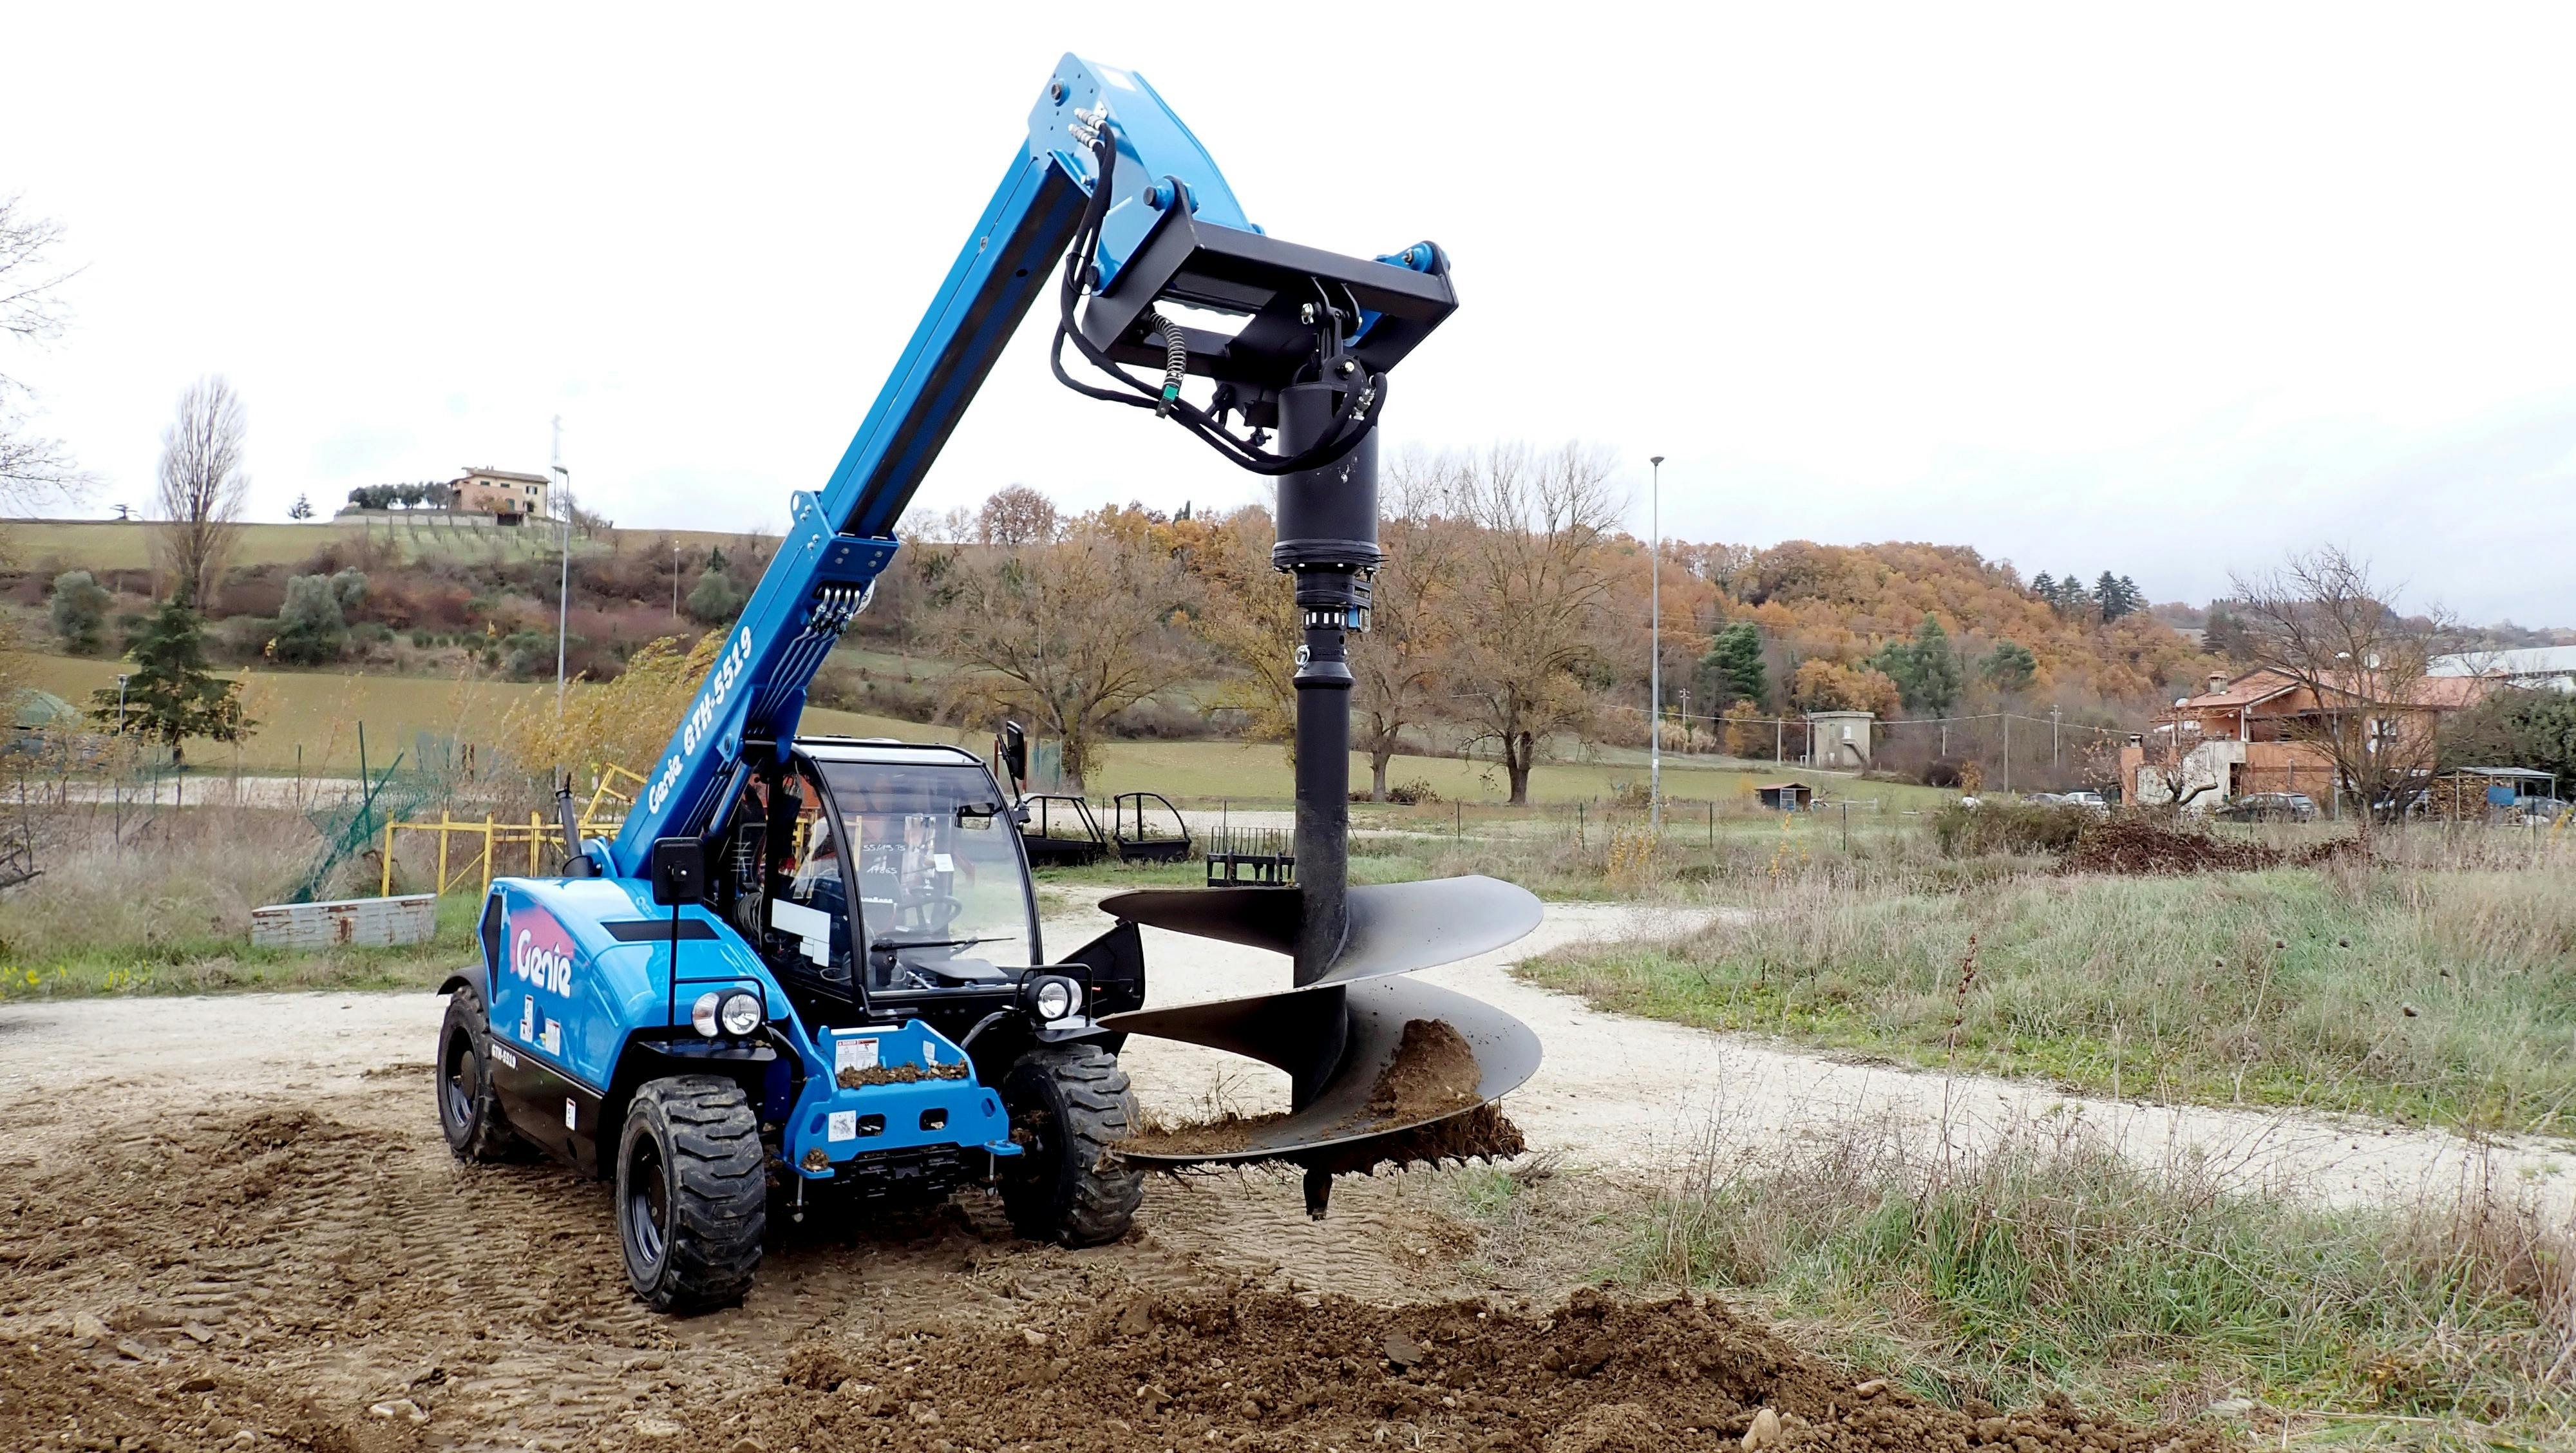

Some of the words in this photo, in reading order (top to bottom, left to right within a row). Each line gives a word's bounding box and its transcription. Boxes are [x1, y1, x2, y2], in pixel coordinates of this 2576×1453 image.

[649, 754, 683, 814] Genie
[684, 626, 752, 756] GTH-5519
[516, 928, 571, 999] Genie
[491, 1043, 516, 1070] GTH-5519
